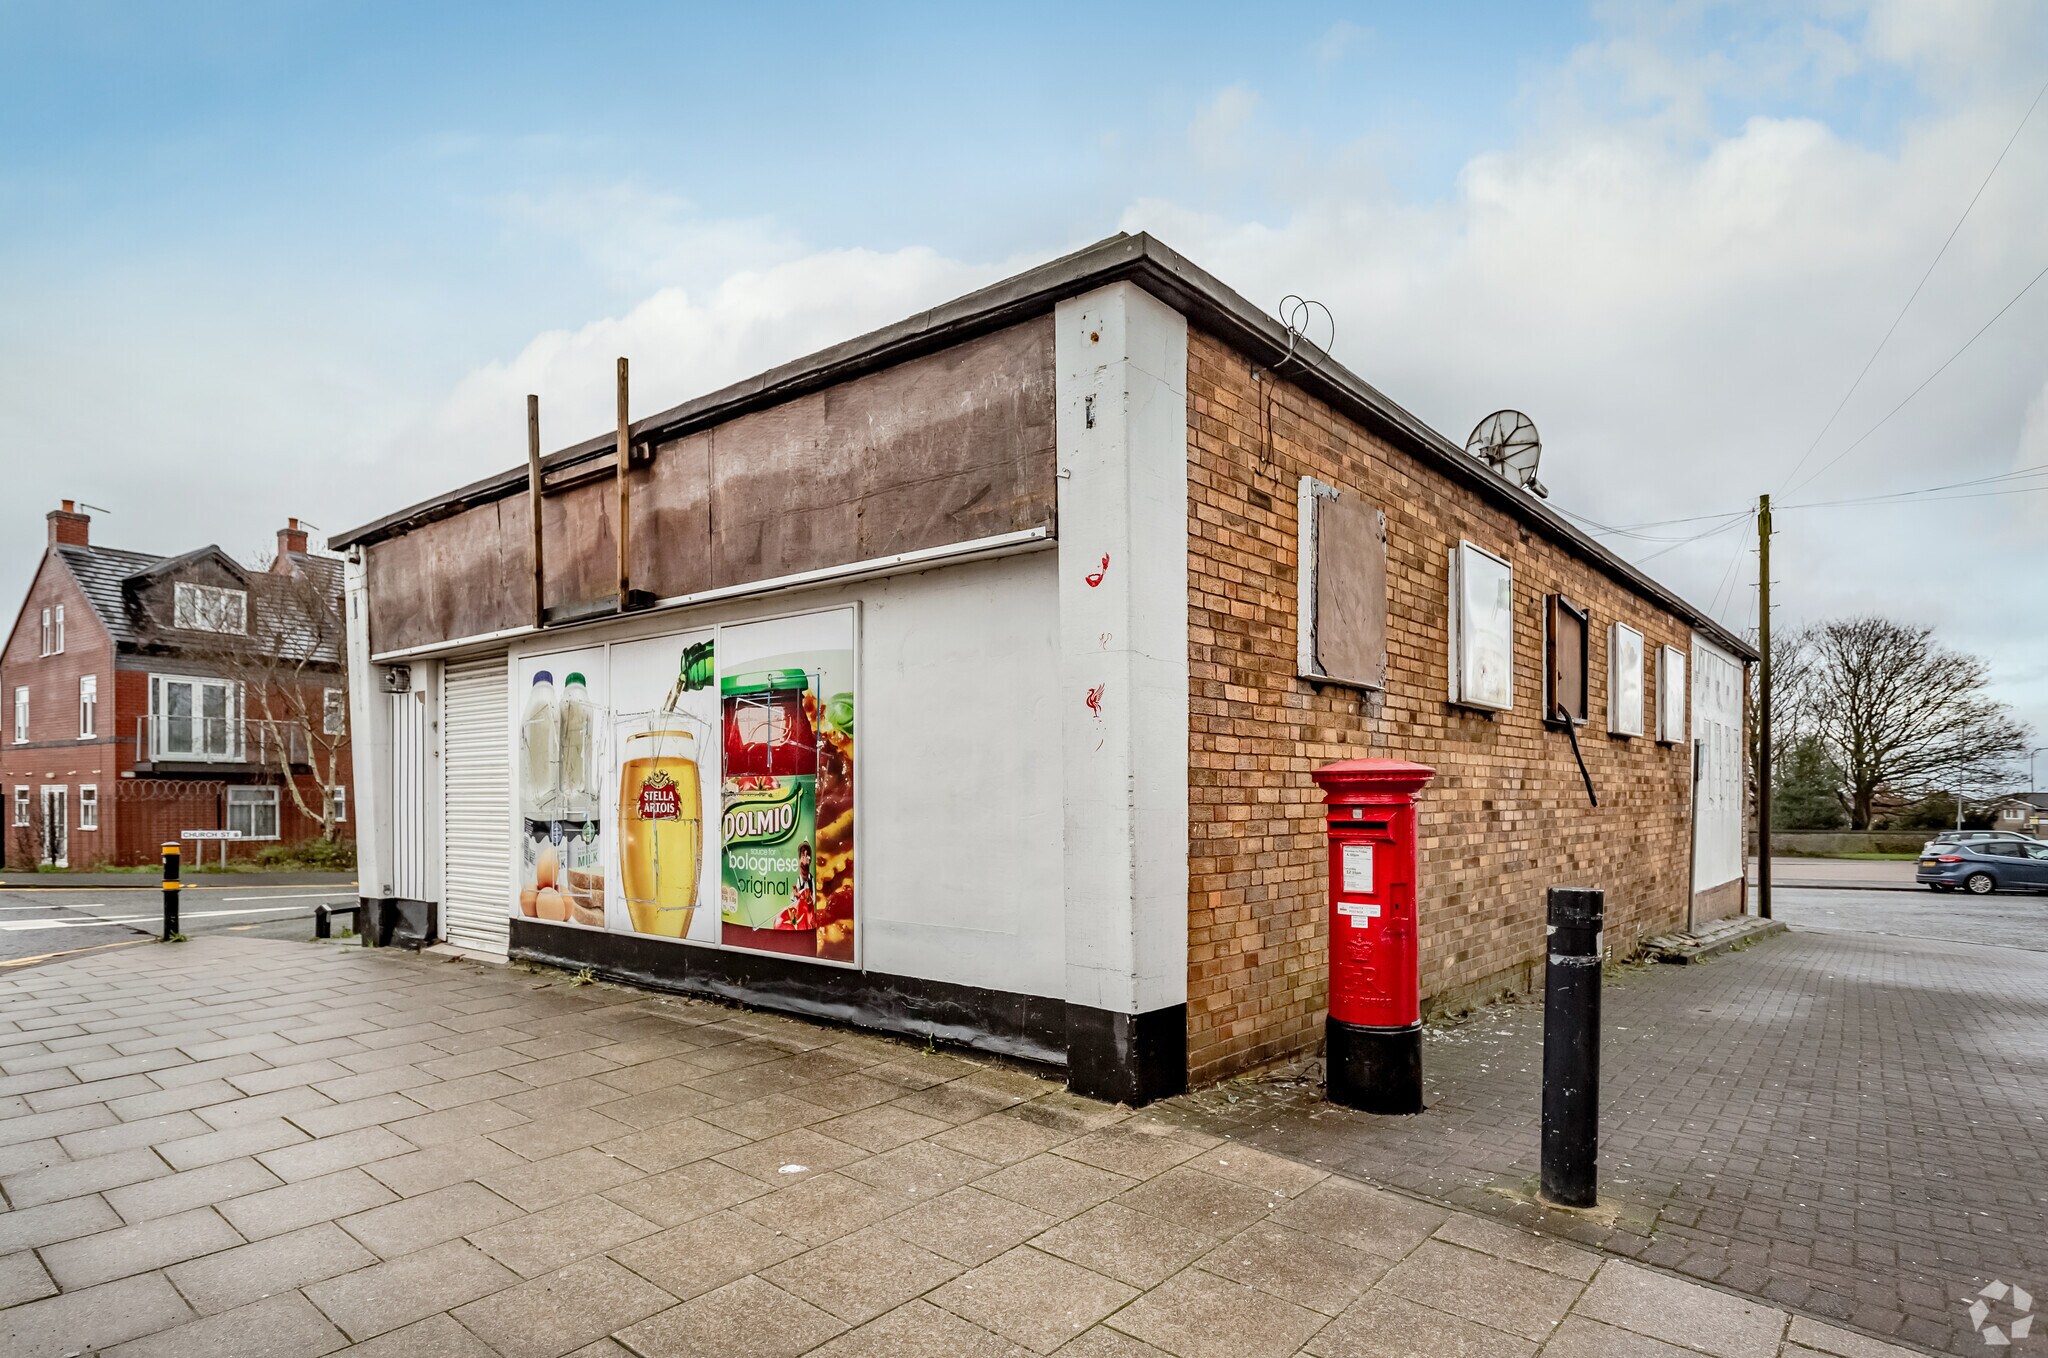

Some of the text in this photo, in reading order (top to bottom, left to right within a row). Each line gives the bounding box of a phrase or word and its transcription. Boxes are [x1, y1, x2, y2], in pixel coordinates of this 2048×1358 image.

[644, 791, 674, 800] STELLA
[644, 802, 675, 812] ARTOIS
[724, 803, 793, 840] DOLMIO
[578, 852, 598, 868] MILK
[729, 850, 799, 876] bolognese
[738, 876, 788, 898] original
